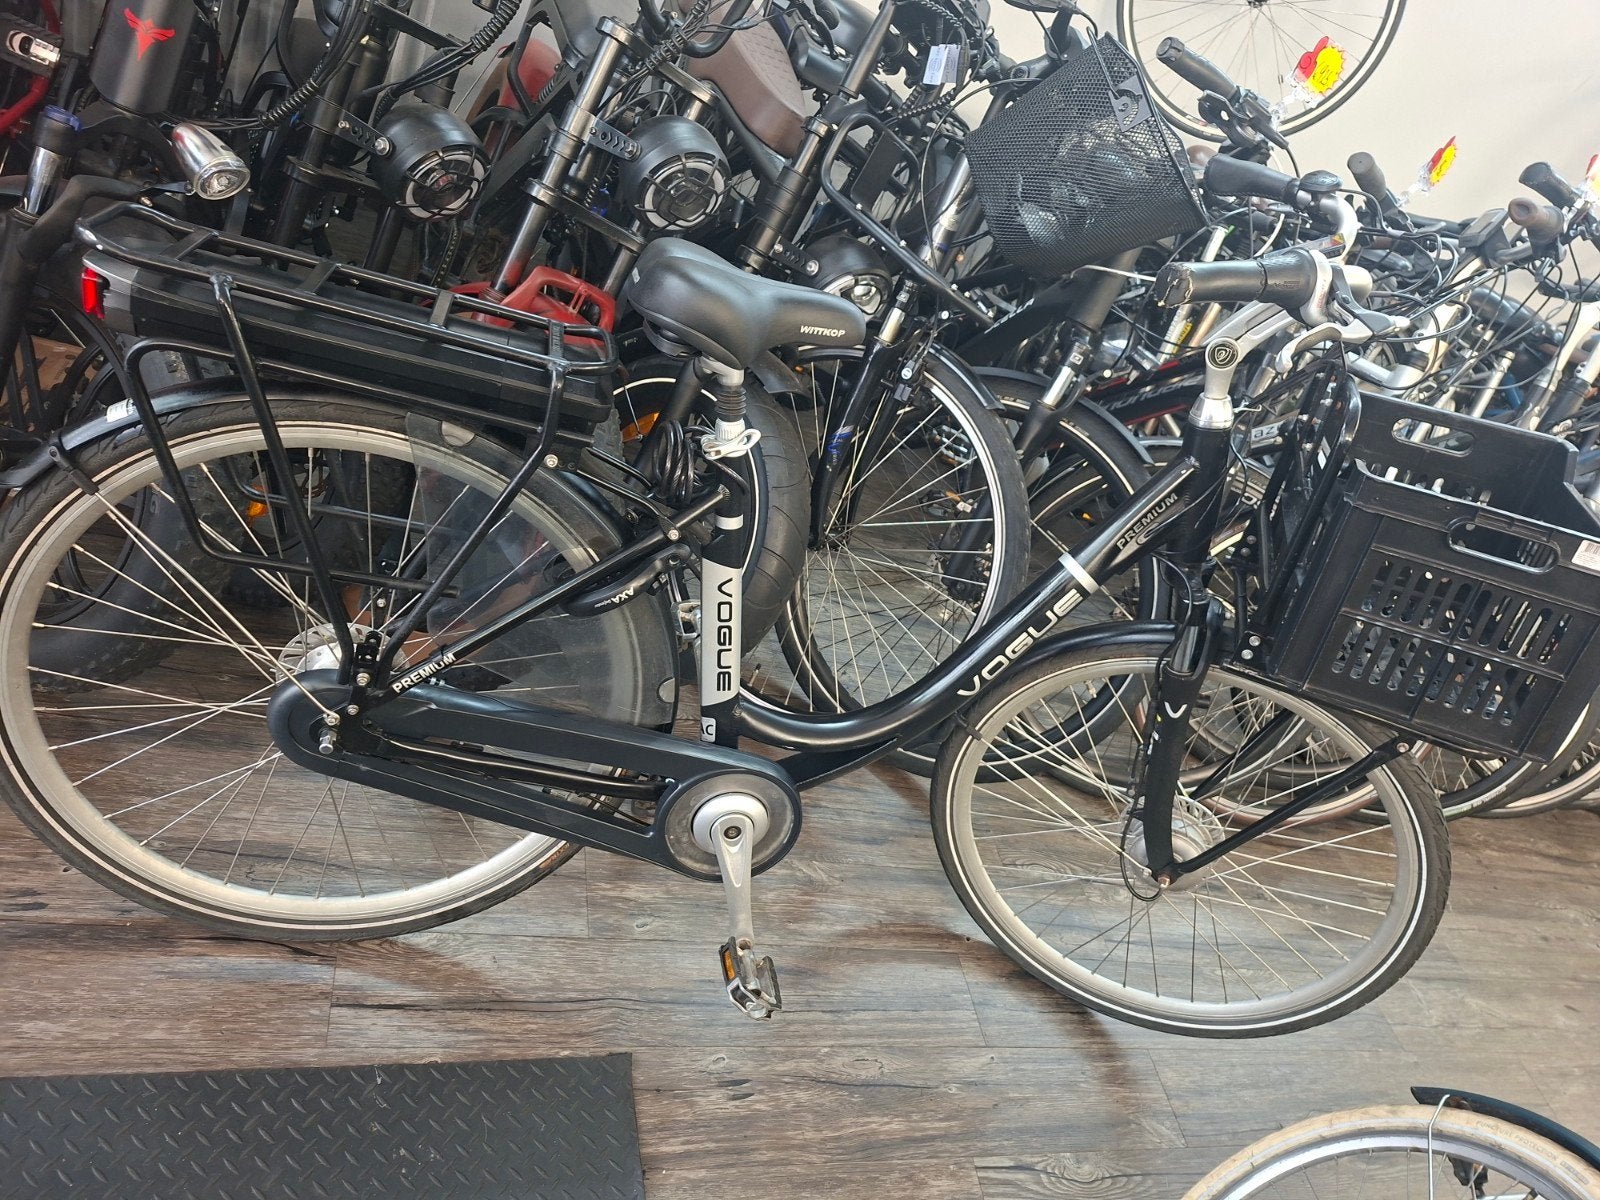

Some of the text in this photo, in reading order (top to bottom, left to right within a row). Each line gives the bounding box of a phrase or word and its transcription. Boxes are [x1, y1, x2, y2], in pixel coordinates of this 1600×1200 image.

[800, 325, 846, 338] WITTKOP
[1116, 492, 1179, 550] PREMIUM
[610, 585, 634, 604] AXA
[716, 577, 734, 692] VOGUE
[956, 588, 1084, 696] VOGUE
[391, 652, 457, 694] PREMIUM
